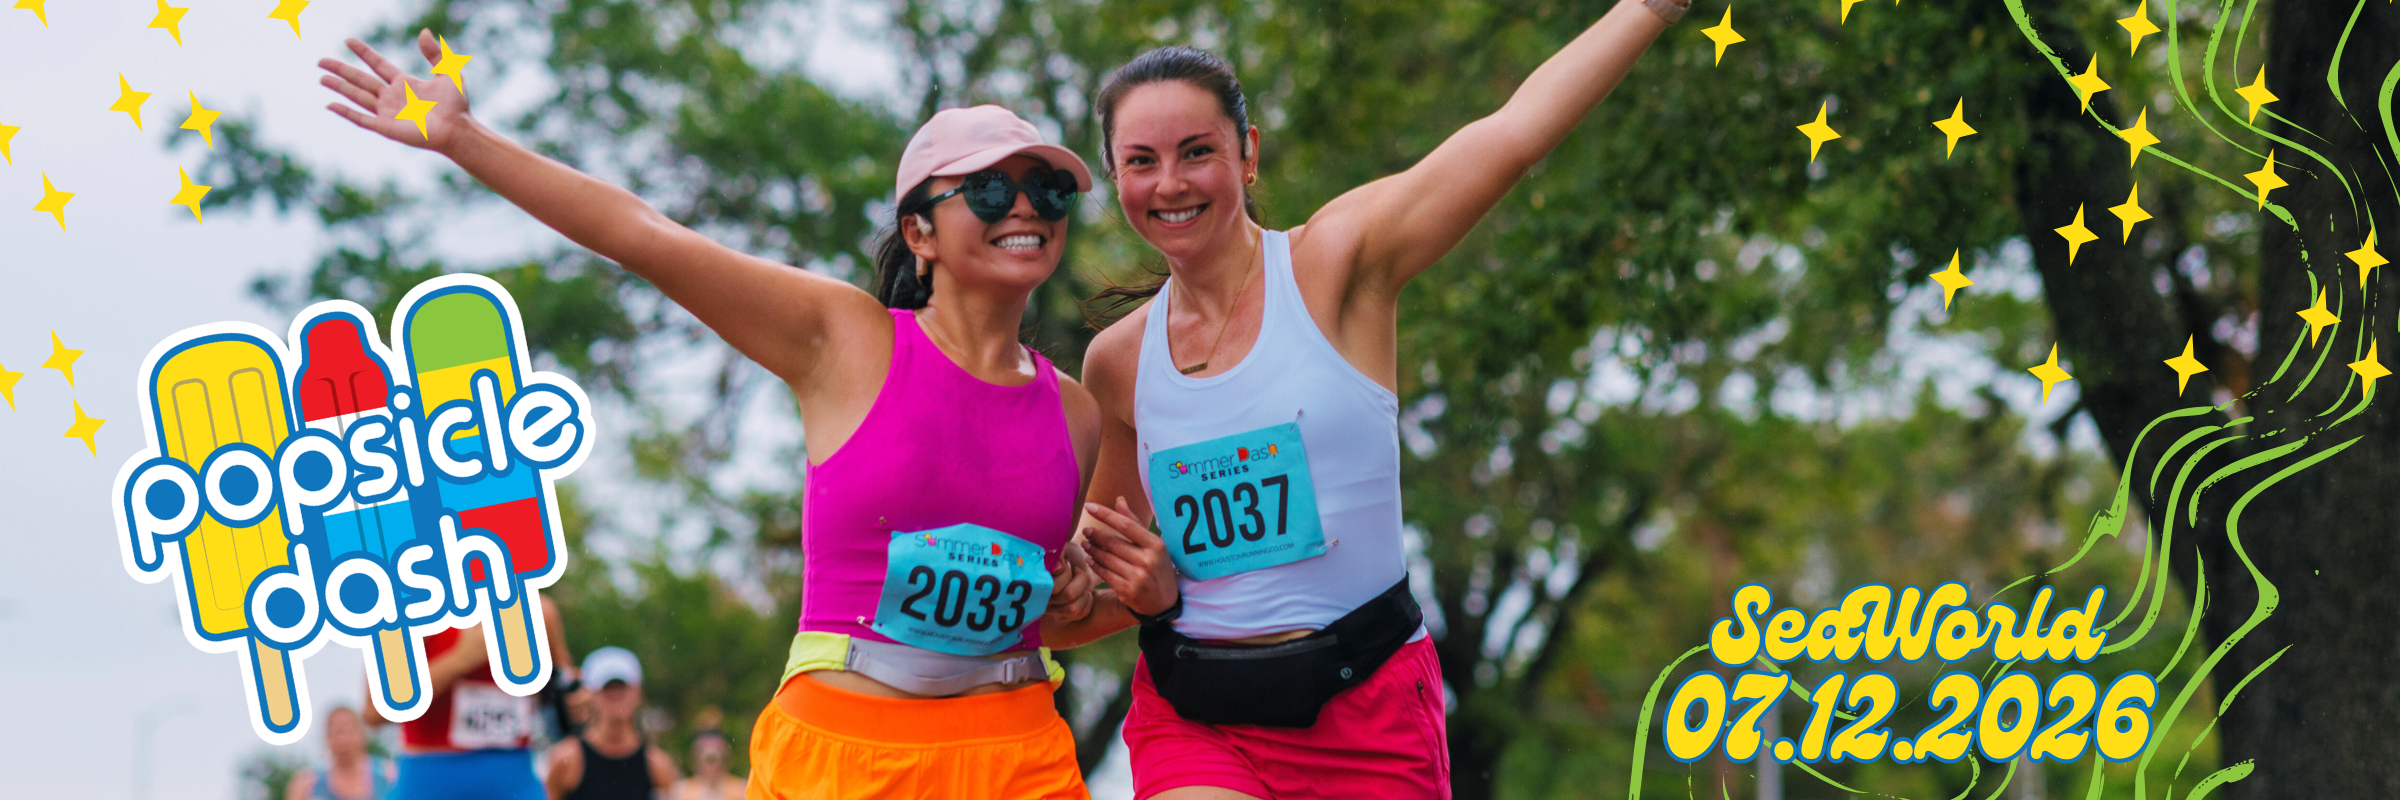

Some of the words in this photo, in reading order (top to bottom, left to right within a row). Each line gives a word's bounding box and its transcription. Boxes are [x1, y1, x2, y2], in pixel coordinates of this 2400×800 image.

[1169, 454, 1235, 478] Summer
[1237, 442, 1278, 462] Dash
[1201, 464, 1249, 481] SERIES
[1174, 474, 1289, 555] 2037
[915, 533, 988, 556] Summer
[949, 552, 998, 567] SERIES
[900, 565, 1032, 633] 2033
